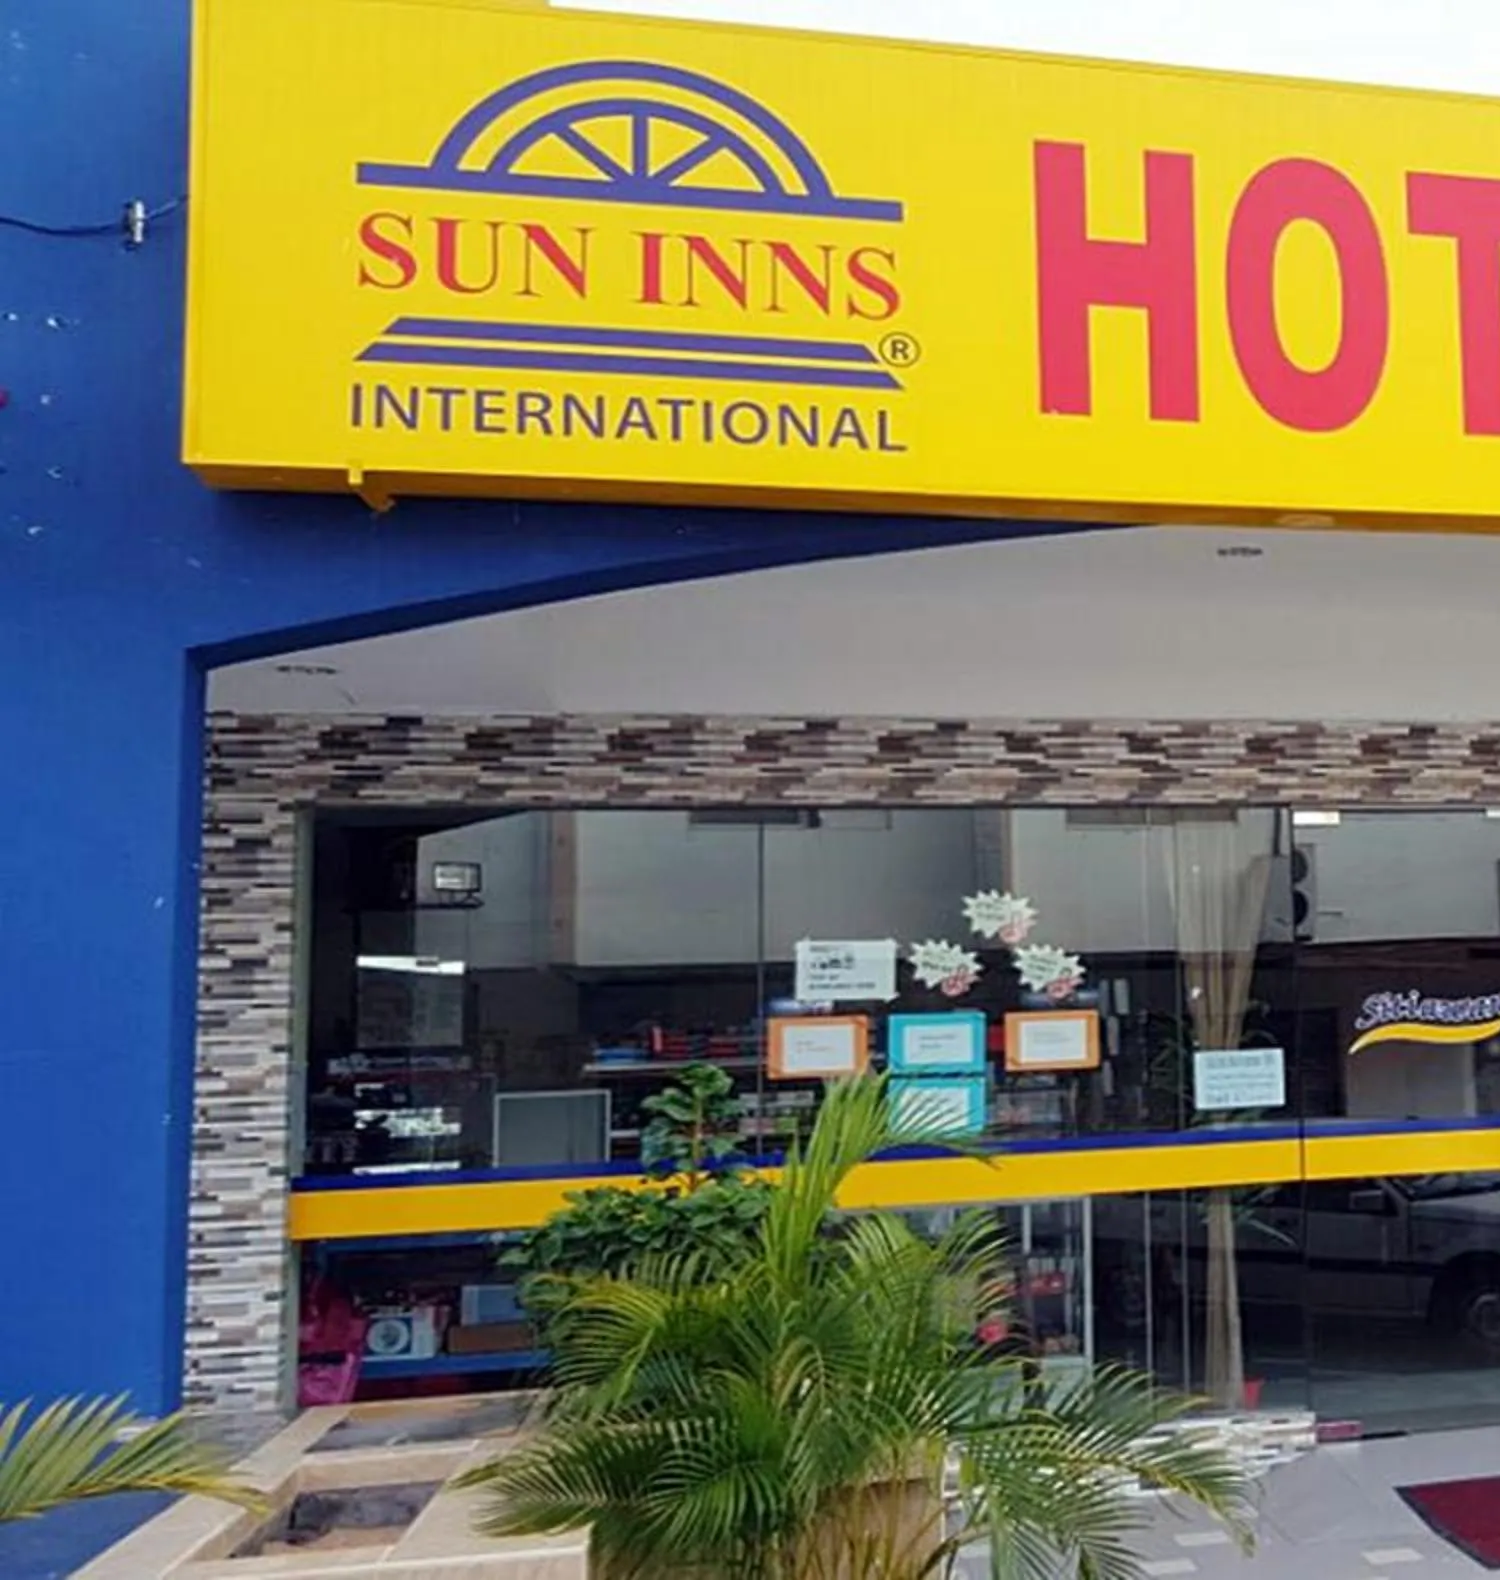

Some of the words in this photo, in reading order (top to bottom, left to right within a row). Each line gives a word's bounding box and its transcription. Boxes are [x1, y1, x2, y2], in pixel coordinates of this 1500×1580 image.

[358, 212, 594, 298] SUN
[632, 231, 902, 320] INNS
[351, 383, 908, 452] INTERNATIONAL
